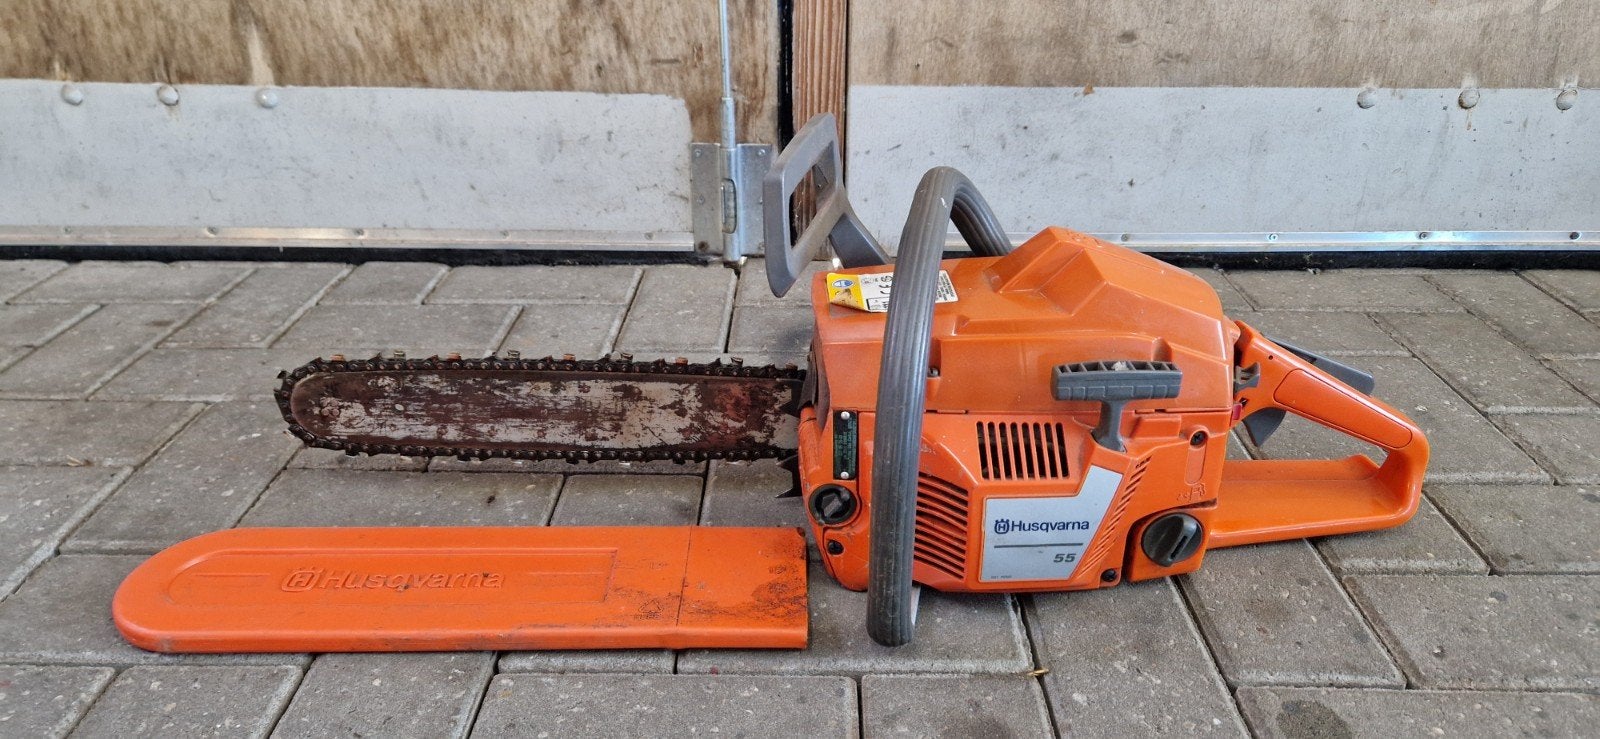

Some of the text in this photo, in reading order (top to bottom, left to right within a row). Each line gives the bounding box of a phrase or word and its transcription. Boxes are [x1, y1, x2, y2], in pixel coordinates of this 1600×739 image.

[1011, 520, 1090, 533] Husqvarna
[1053, 553, 1077, 563] 55
[318, 568, 506, 592] Husqvarna
